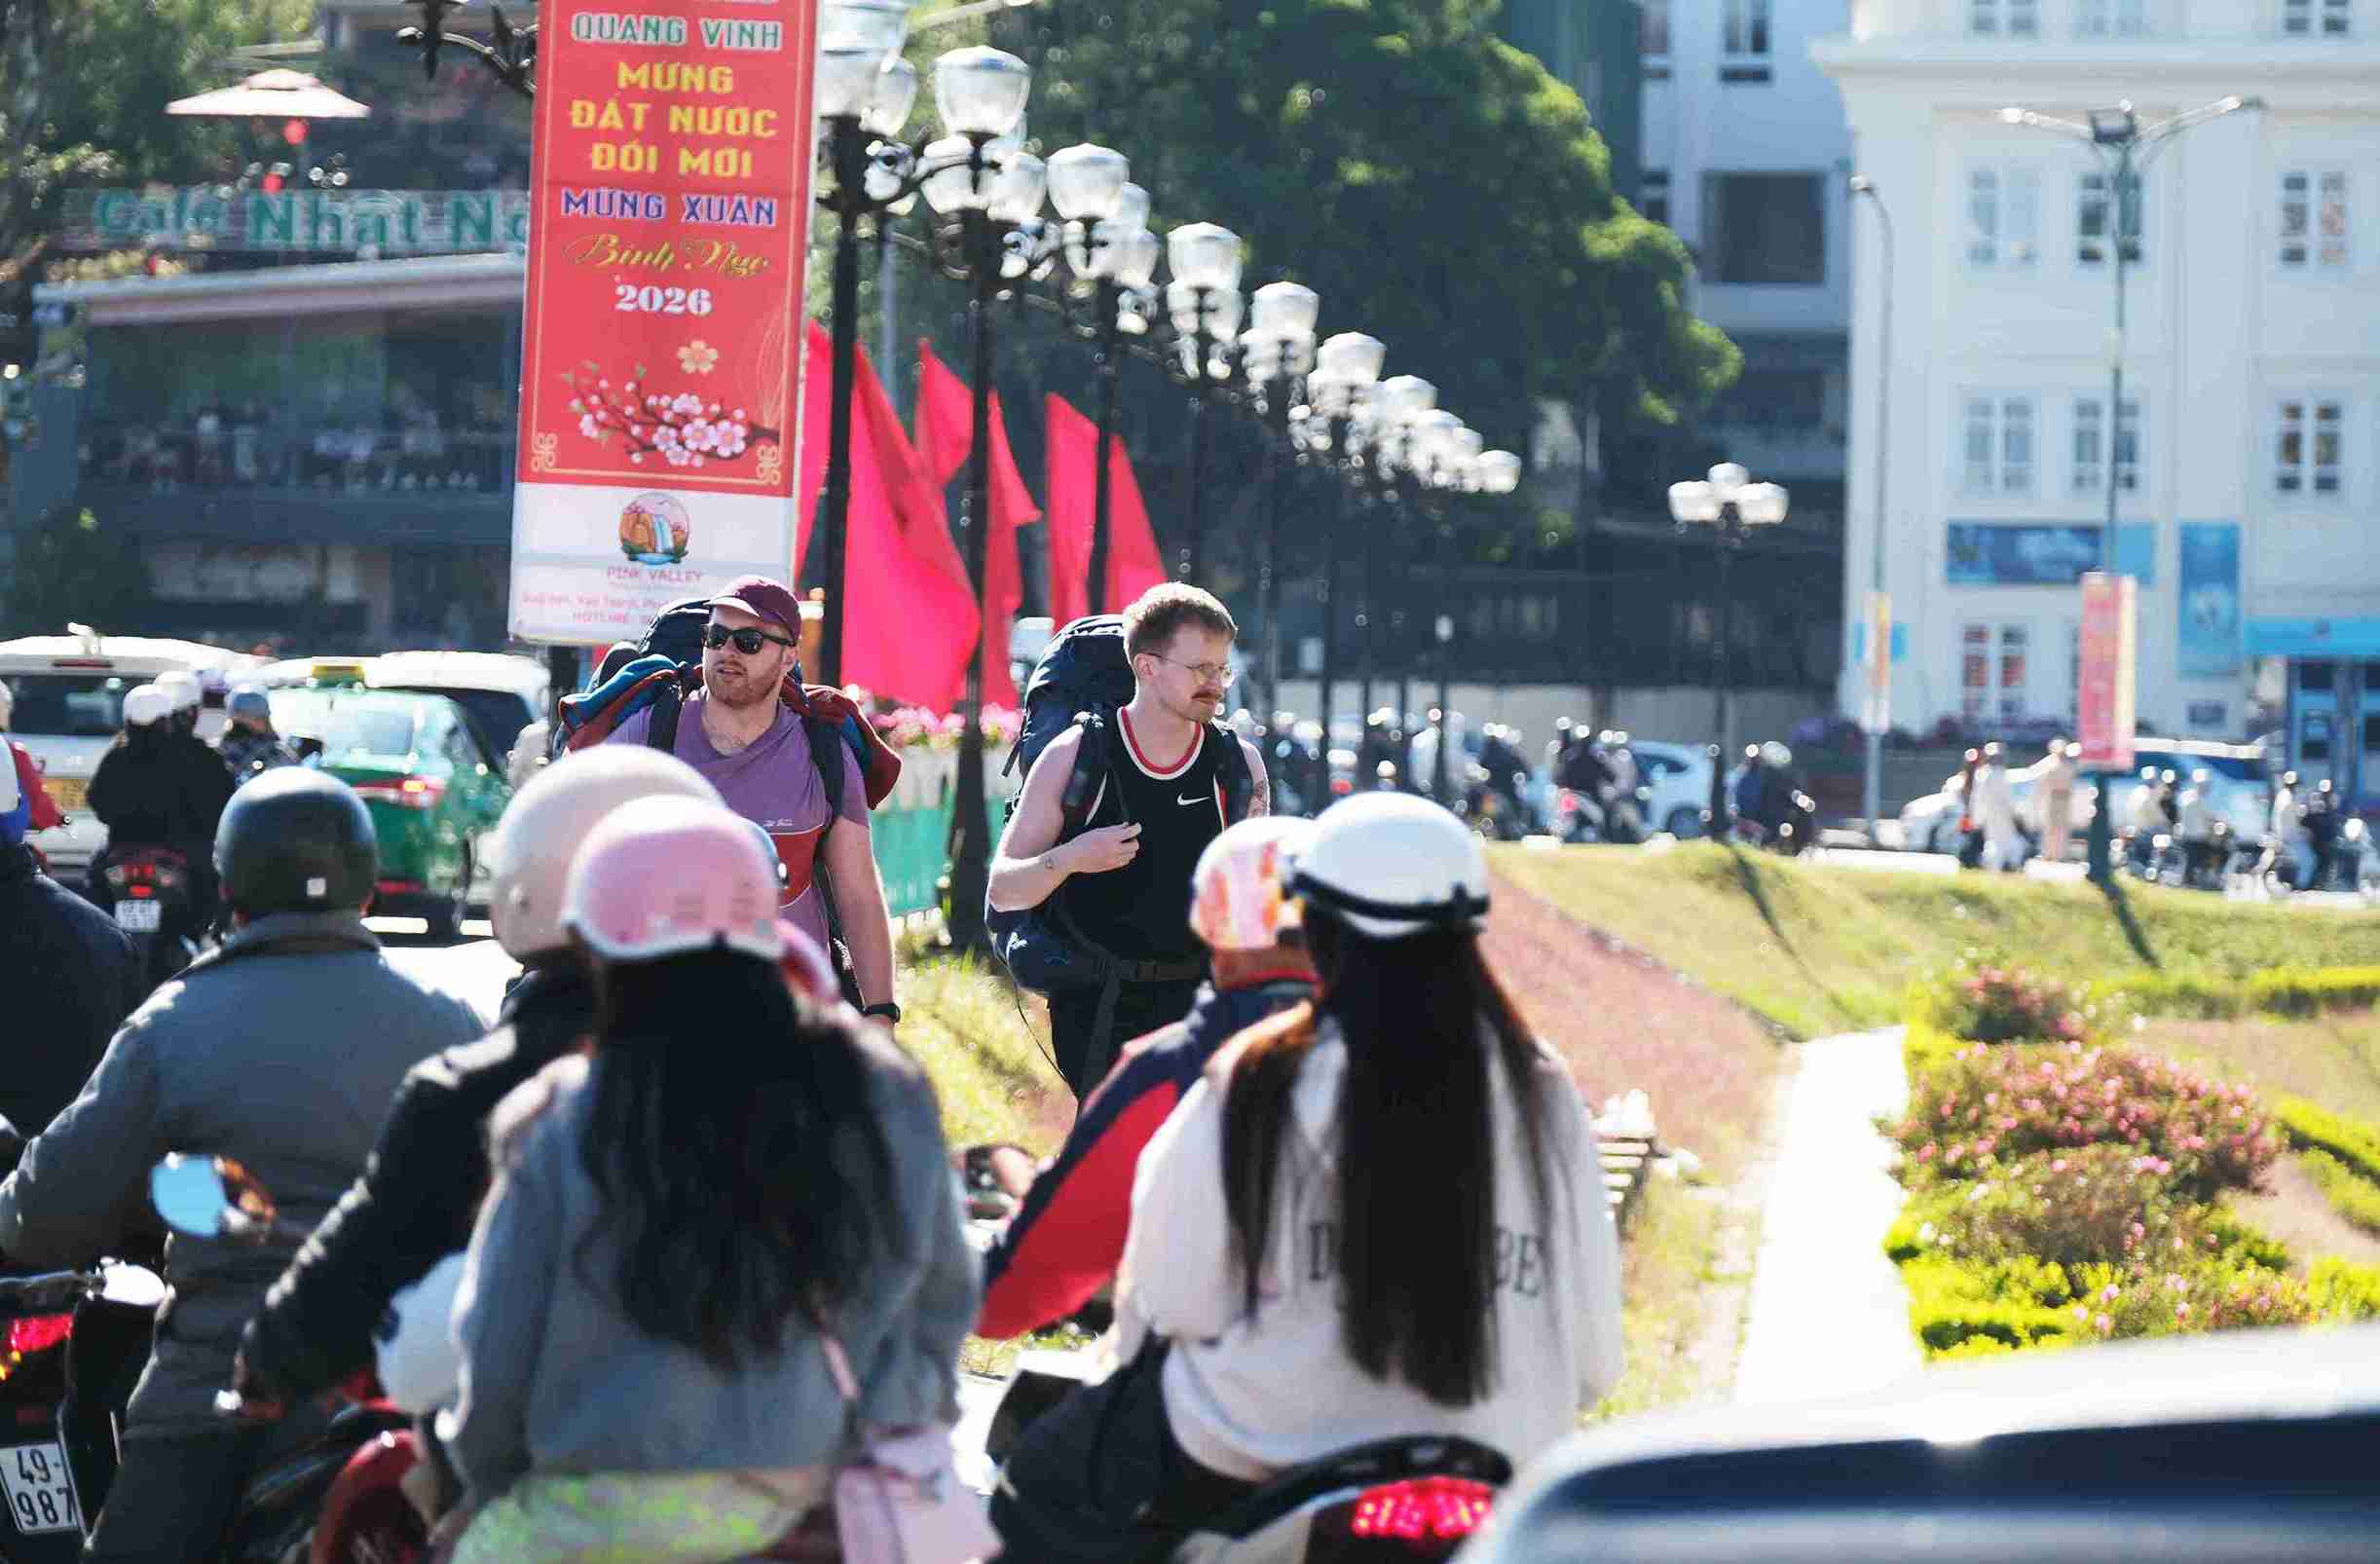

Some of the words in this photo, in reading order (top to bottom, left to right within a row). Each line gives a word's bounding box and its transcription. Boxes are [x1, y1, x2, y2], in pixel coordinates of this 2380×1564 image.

[573, 13, 686, 46] QUANG
[699, 19, 783, 51] VINH
[682, 191, 778, 227] XUÂN
[614, 283, 713, 317] 2026
[607, 565, 639, 579] PINK
[649, 567, 703, 583] VALLEY
